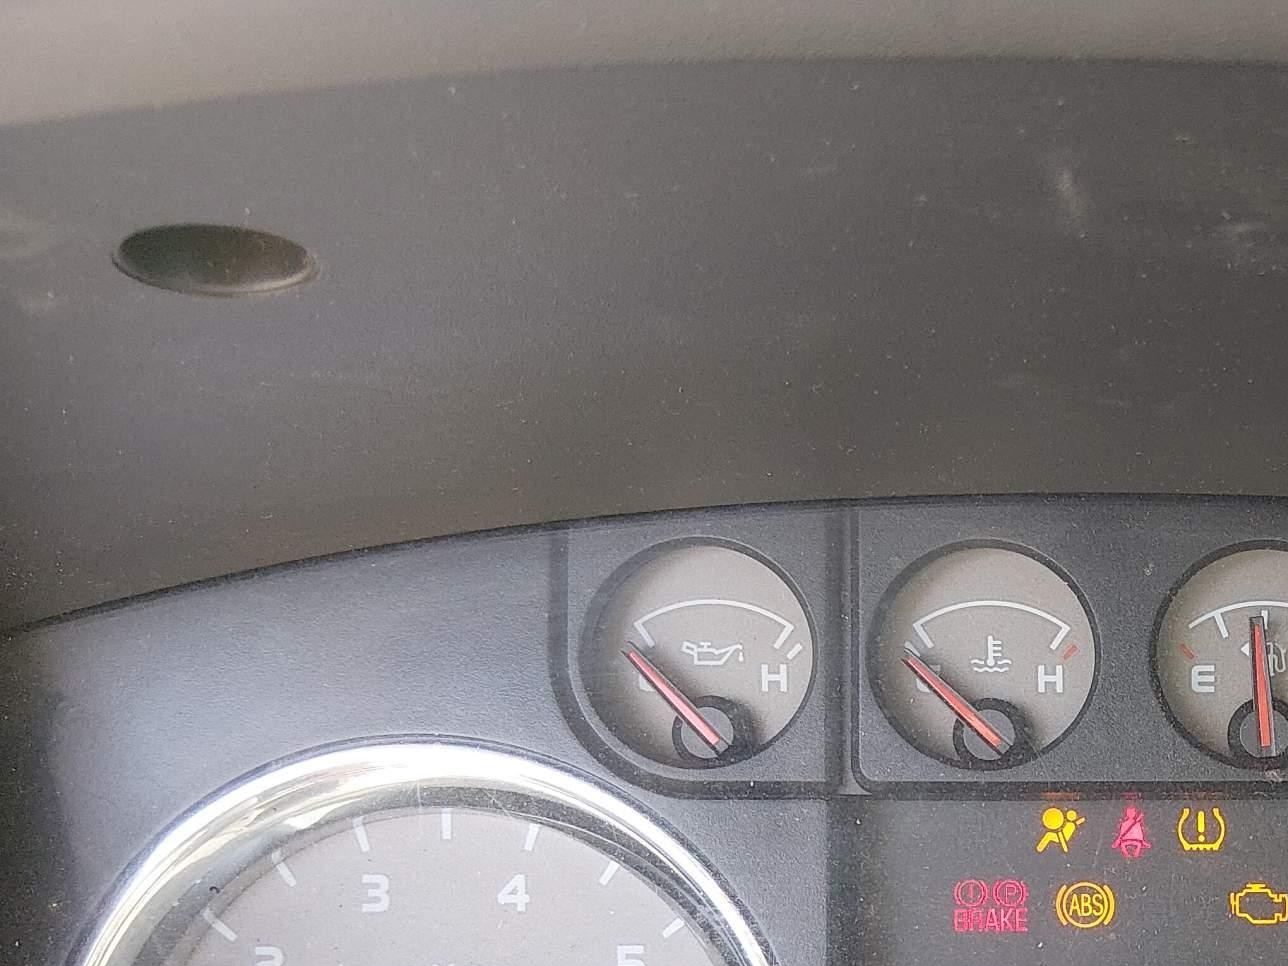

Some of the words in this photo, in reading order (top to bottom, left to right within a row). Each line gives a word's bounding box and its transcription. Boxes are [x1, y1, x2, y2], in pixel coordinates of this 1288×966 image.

[761, 664, 788, 692] H
[1037, 665, 1064, 693] H
[1191, 665, 1215, 693] E
[361, 874, 390, 913] 3
[497, 874, 531, 912] 4
[1069, 892, 1104, 917] ABS
[953, 908, 1028, 932] BRAKE
